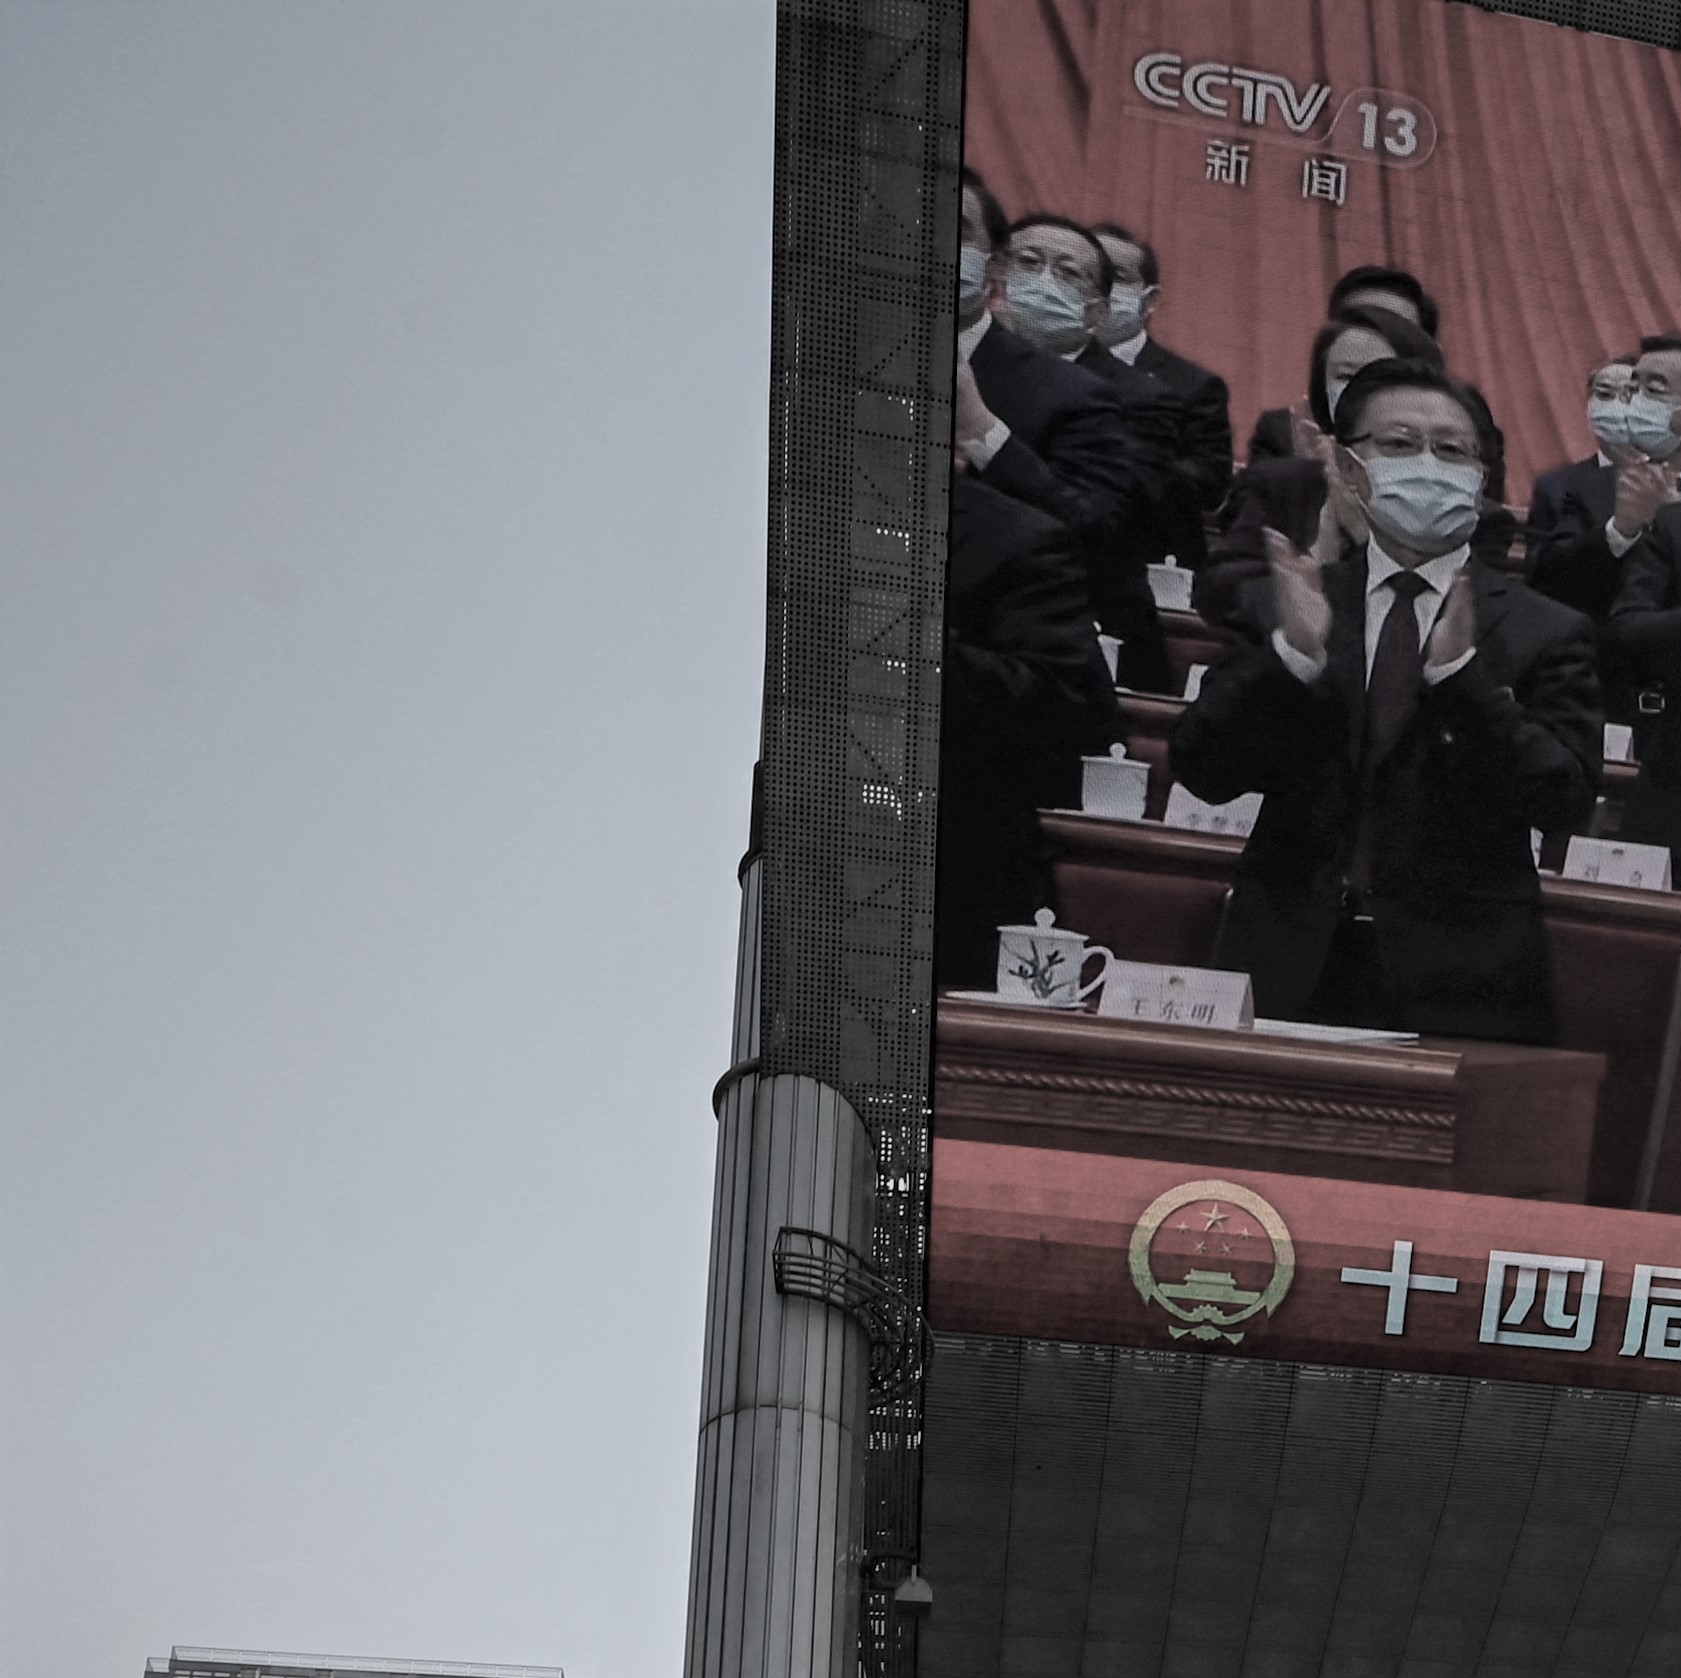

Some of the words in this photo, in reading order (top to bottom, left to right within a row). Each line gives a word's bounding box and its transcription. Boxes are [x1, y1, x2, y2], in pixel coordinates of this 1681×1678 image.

[1133, 50, 1329, 134] CCTV
[1356, 101, 1418, 157] 13
[1205, 139, 1348, 206] 新闻
